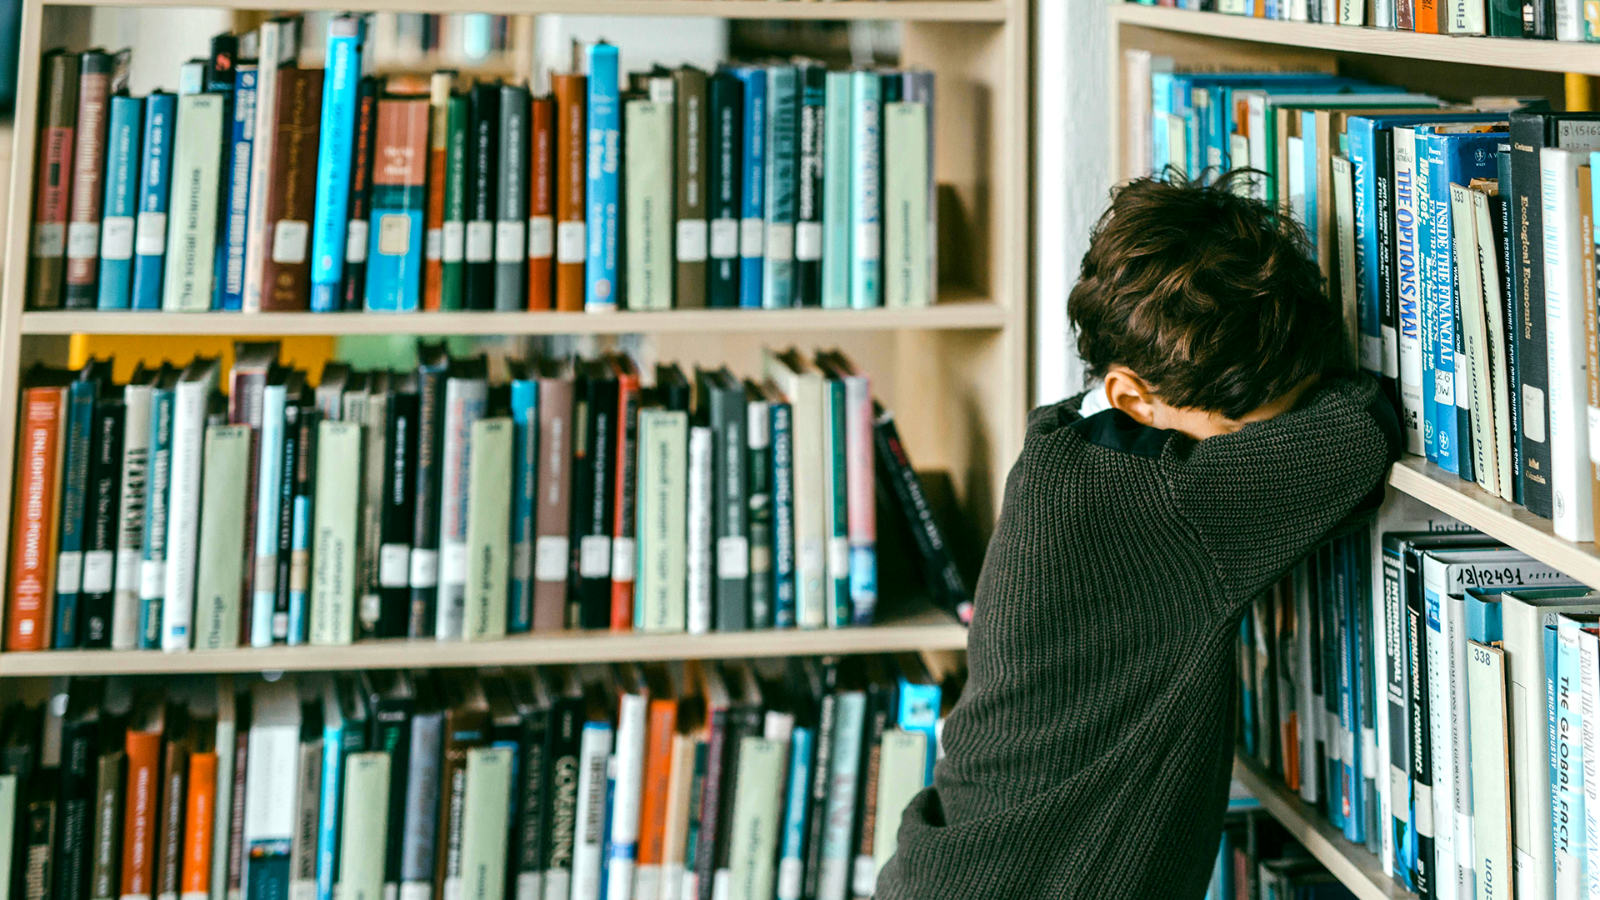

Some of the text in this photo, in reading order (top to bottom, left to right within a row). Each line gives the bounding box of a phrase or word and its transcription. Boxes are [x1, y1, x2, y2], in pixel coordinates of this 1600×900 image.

[1397, 168, 1412, 208] THE
[1397, 208, 1417, 296] OPTIONS
[1436, 200, 1453, 365] INSIDE THE FINANCIAL
[1520, 195, 1533, 341] Ecological Economics
[1505, 276, 1513, 330] POLICYMAKING
[1468, 336, 1485, 485] Land economics
[27, 428, 48, 521] ENLIGHTENED
[23, 521, 43, 571] POWER
[1386, 578, 1394, 657] ECONOMICS
[1391, 581, 1402, 683] INTERNATIONAL
[1474, 648, 1491, 666] 338
[1580, 647, 1592, 688] FROM
[1410, 614, 1422, 774] INTERNATIONAL ECONOMICS
[1561, 676, 1569, 710] THE
[1581, 689, 1593, 715] THE
[1549, 724, 1557, 769] INDUSTRY
[1560, 717, 1569, 792] GLOBAL
[1585, 779, 1596, 800] UP
